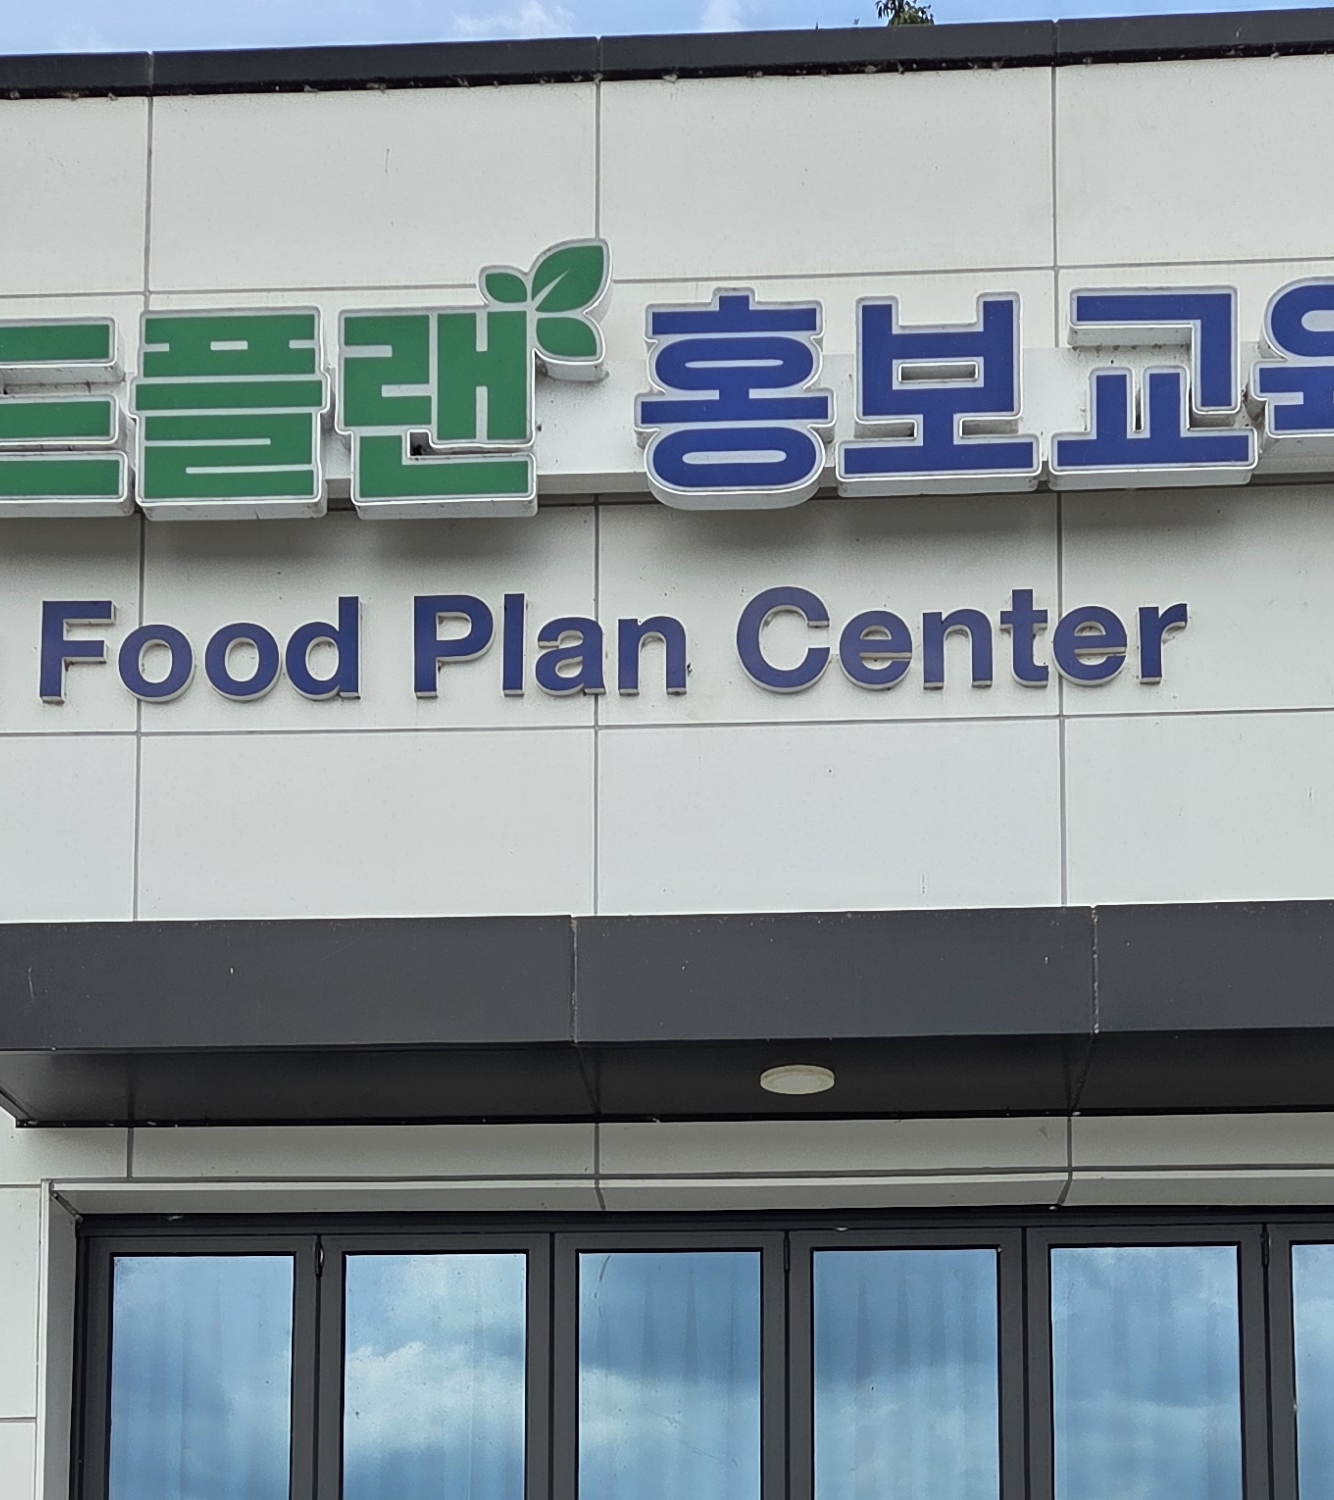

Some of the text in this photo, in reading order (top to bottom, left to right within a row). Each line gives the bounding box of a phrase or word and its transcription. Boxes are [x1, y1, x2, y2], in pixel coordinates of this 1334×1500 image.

[39, 596, 363, 704] Food
[413, 593, 689, 699] Plan
[736, 586, 1188, 695] Center
